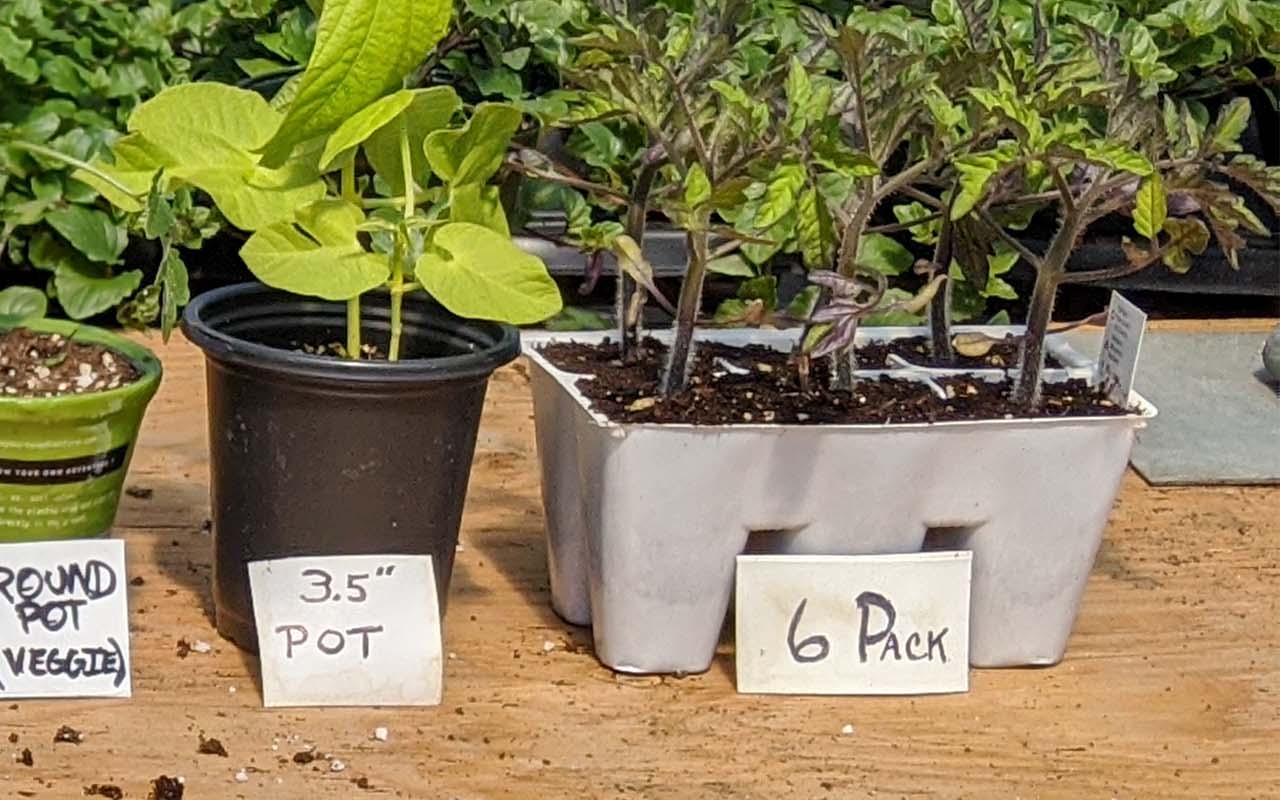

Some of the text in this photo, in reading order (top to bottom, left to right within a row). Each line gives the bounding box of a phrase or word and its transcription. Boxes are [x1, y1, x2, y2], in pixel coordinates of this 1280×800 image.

[300, 564, 396, 604] 3.5"
[14, 599, 88, 634] POT
[787, 597, 830, 664] 6
[274, 624, 384, 660] POT
